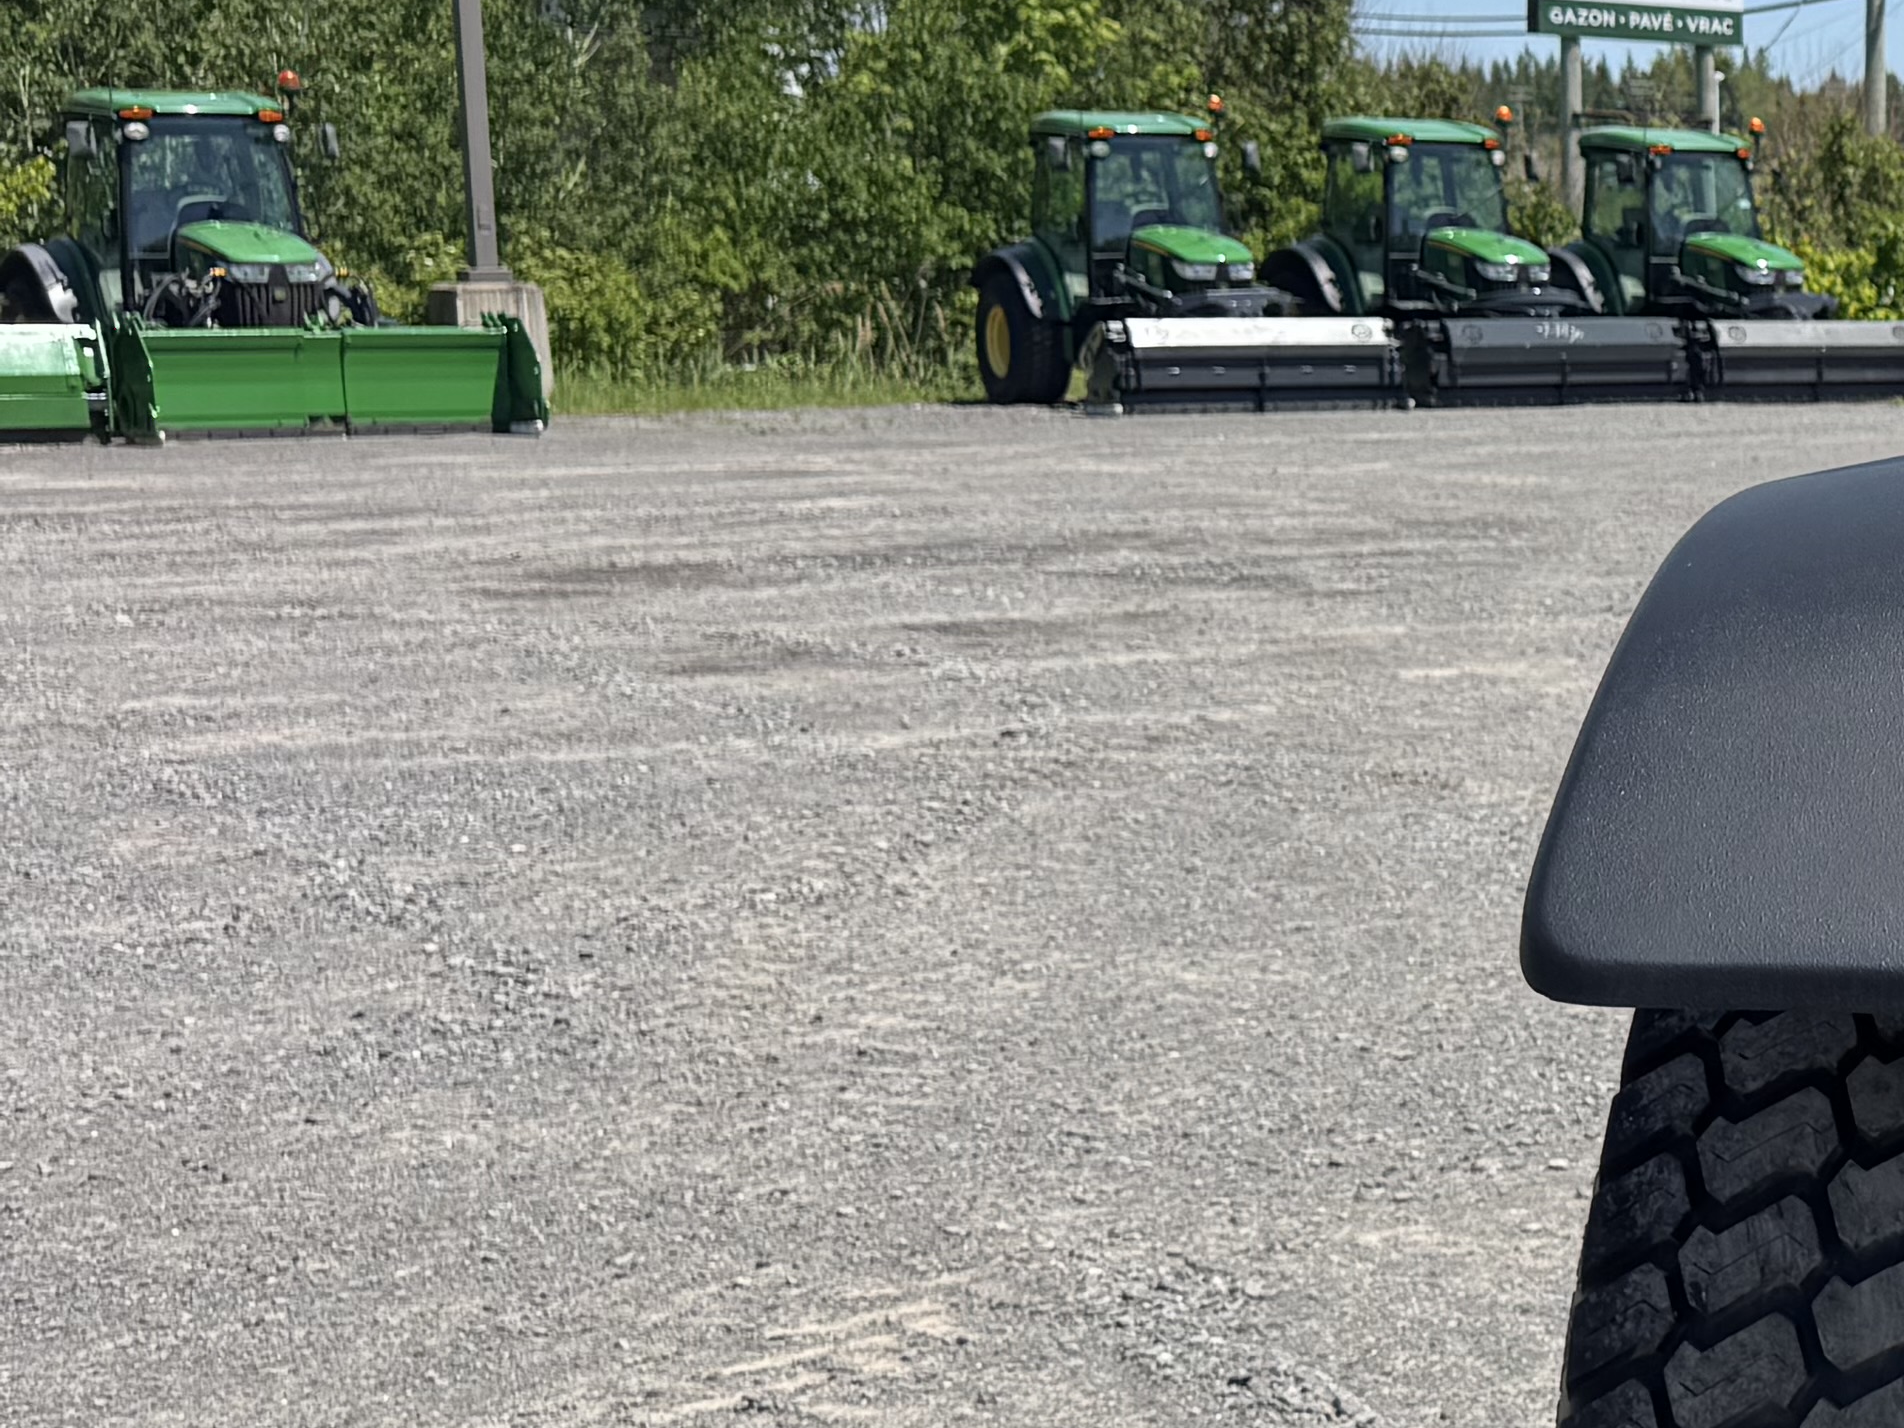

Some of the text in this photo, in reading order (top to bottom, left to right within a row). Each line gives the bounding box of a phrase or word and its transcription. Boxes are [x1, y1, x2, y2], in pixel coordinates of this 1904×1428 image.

[1550, 6, 1734, 36] GAZON PAVÉ VRAC
